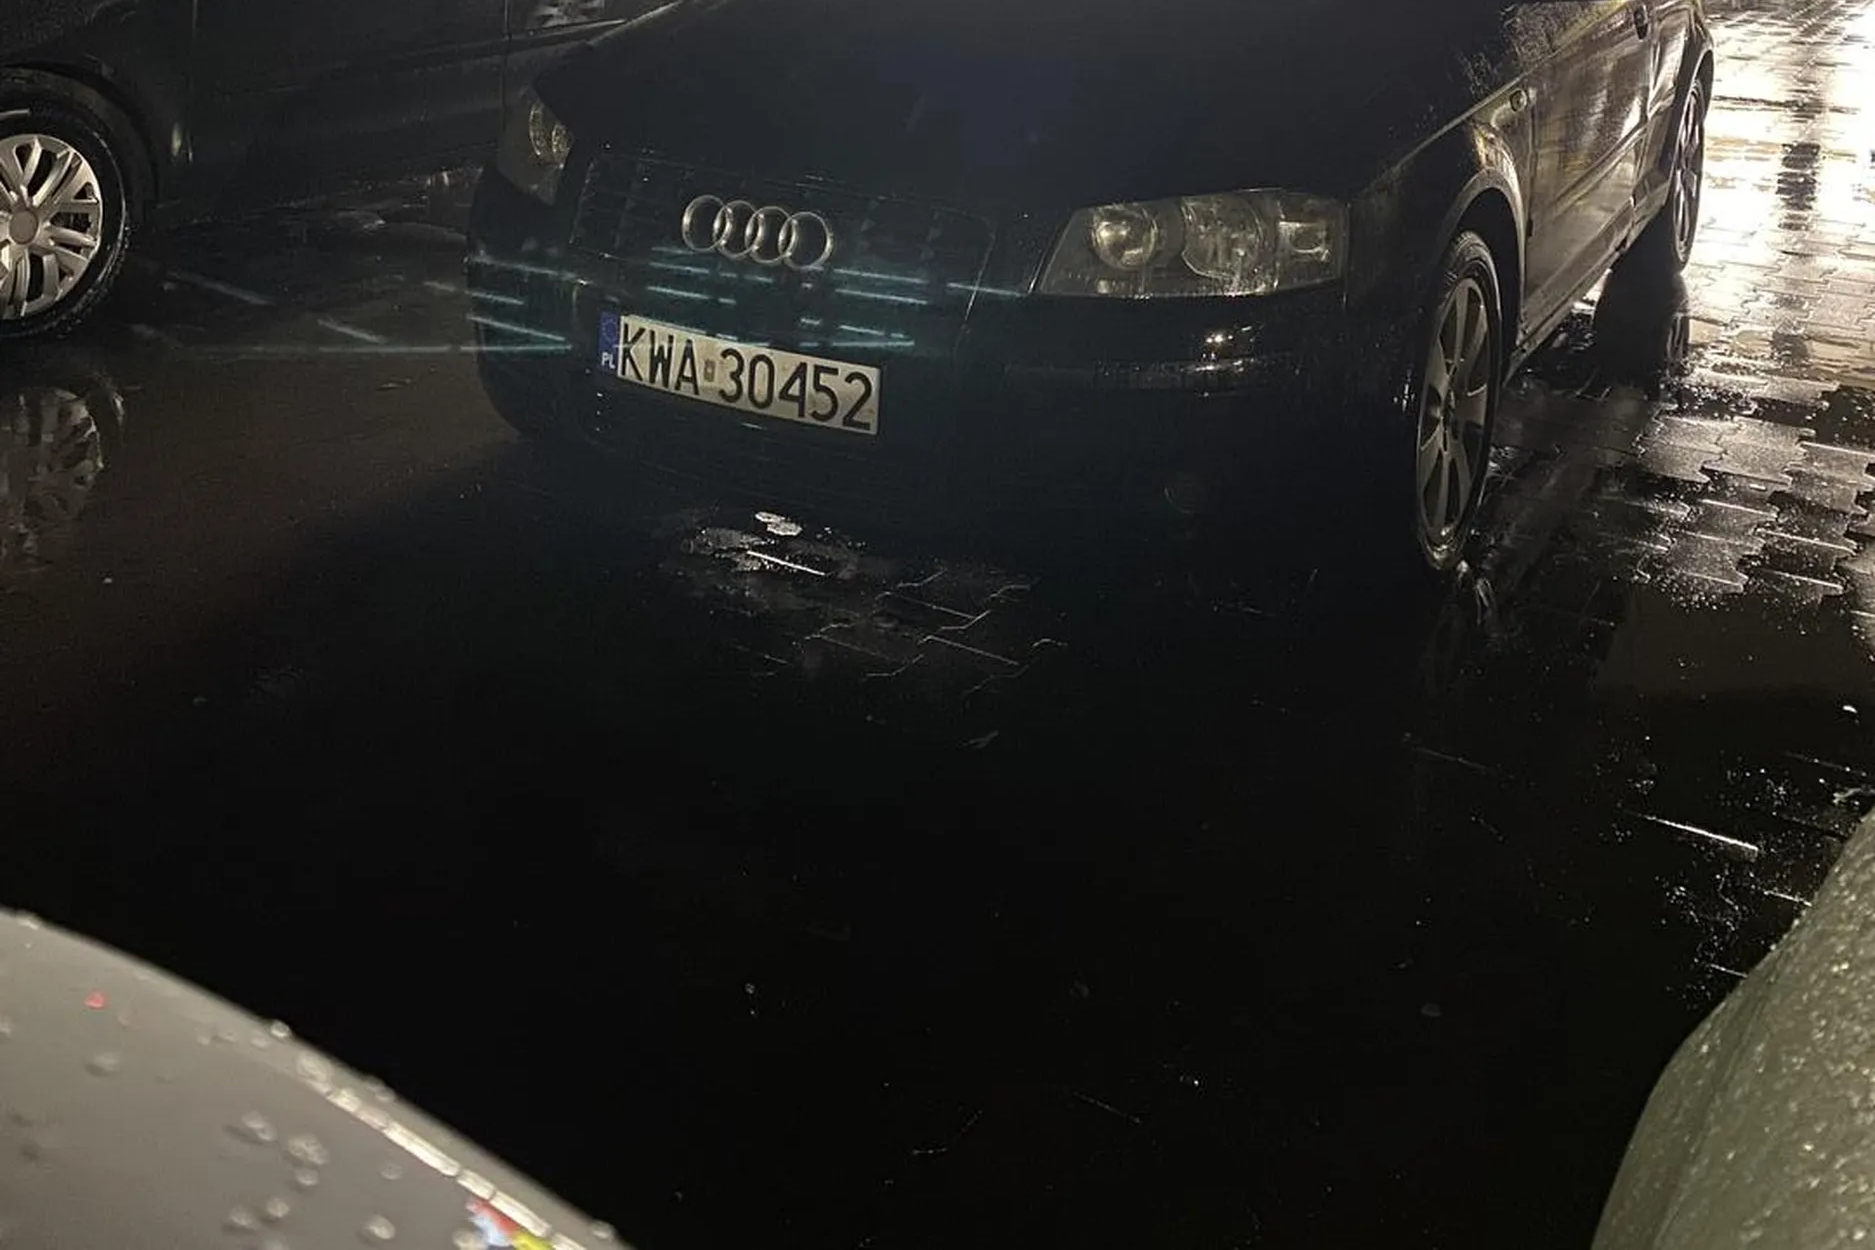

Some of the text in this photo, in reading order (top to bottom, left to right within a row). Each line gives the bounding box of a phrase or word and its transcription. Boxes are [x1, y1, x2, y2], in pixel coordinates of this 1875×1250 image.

[601, 351, 616, 370] PL
[620, 323, 873, 431] KWA 30452
